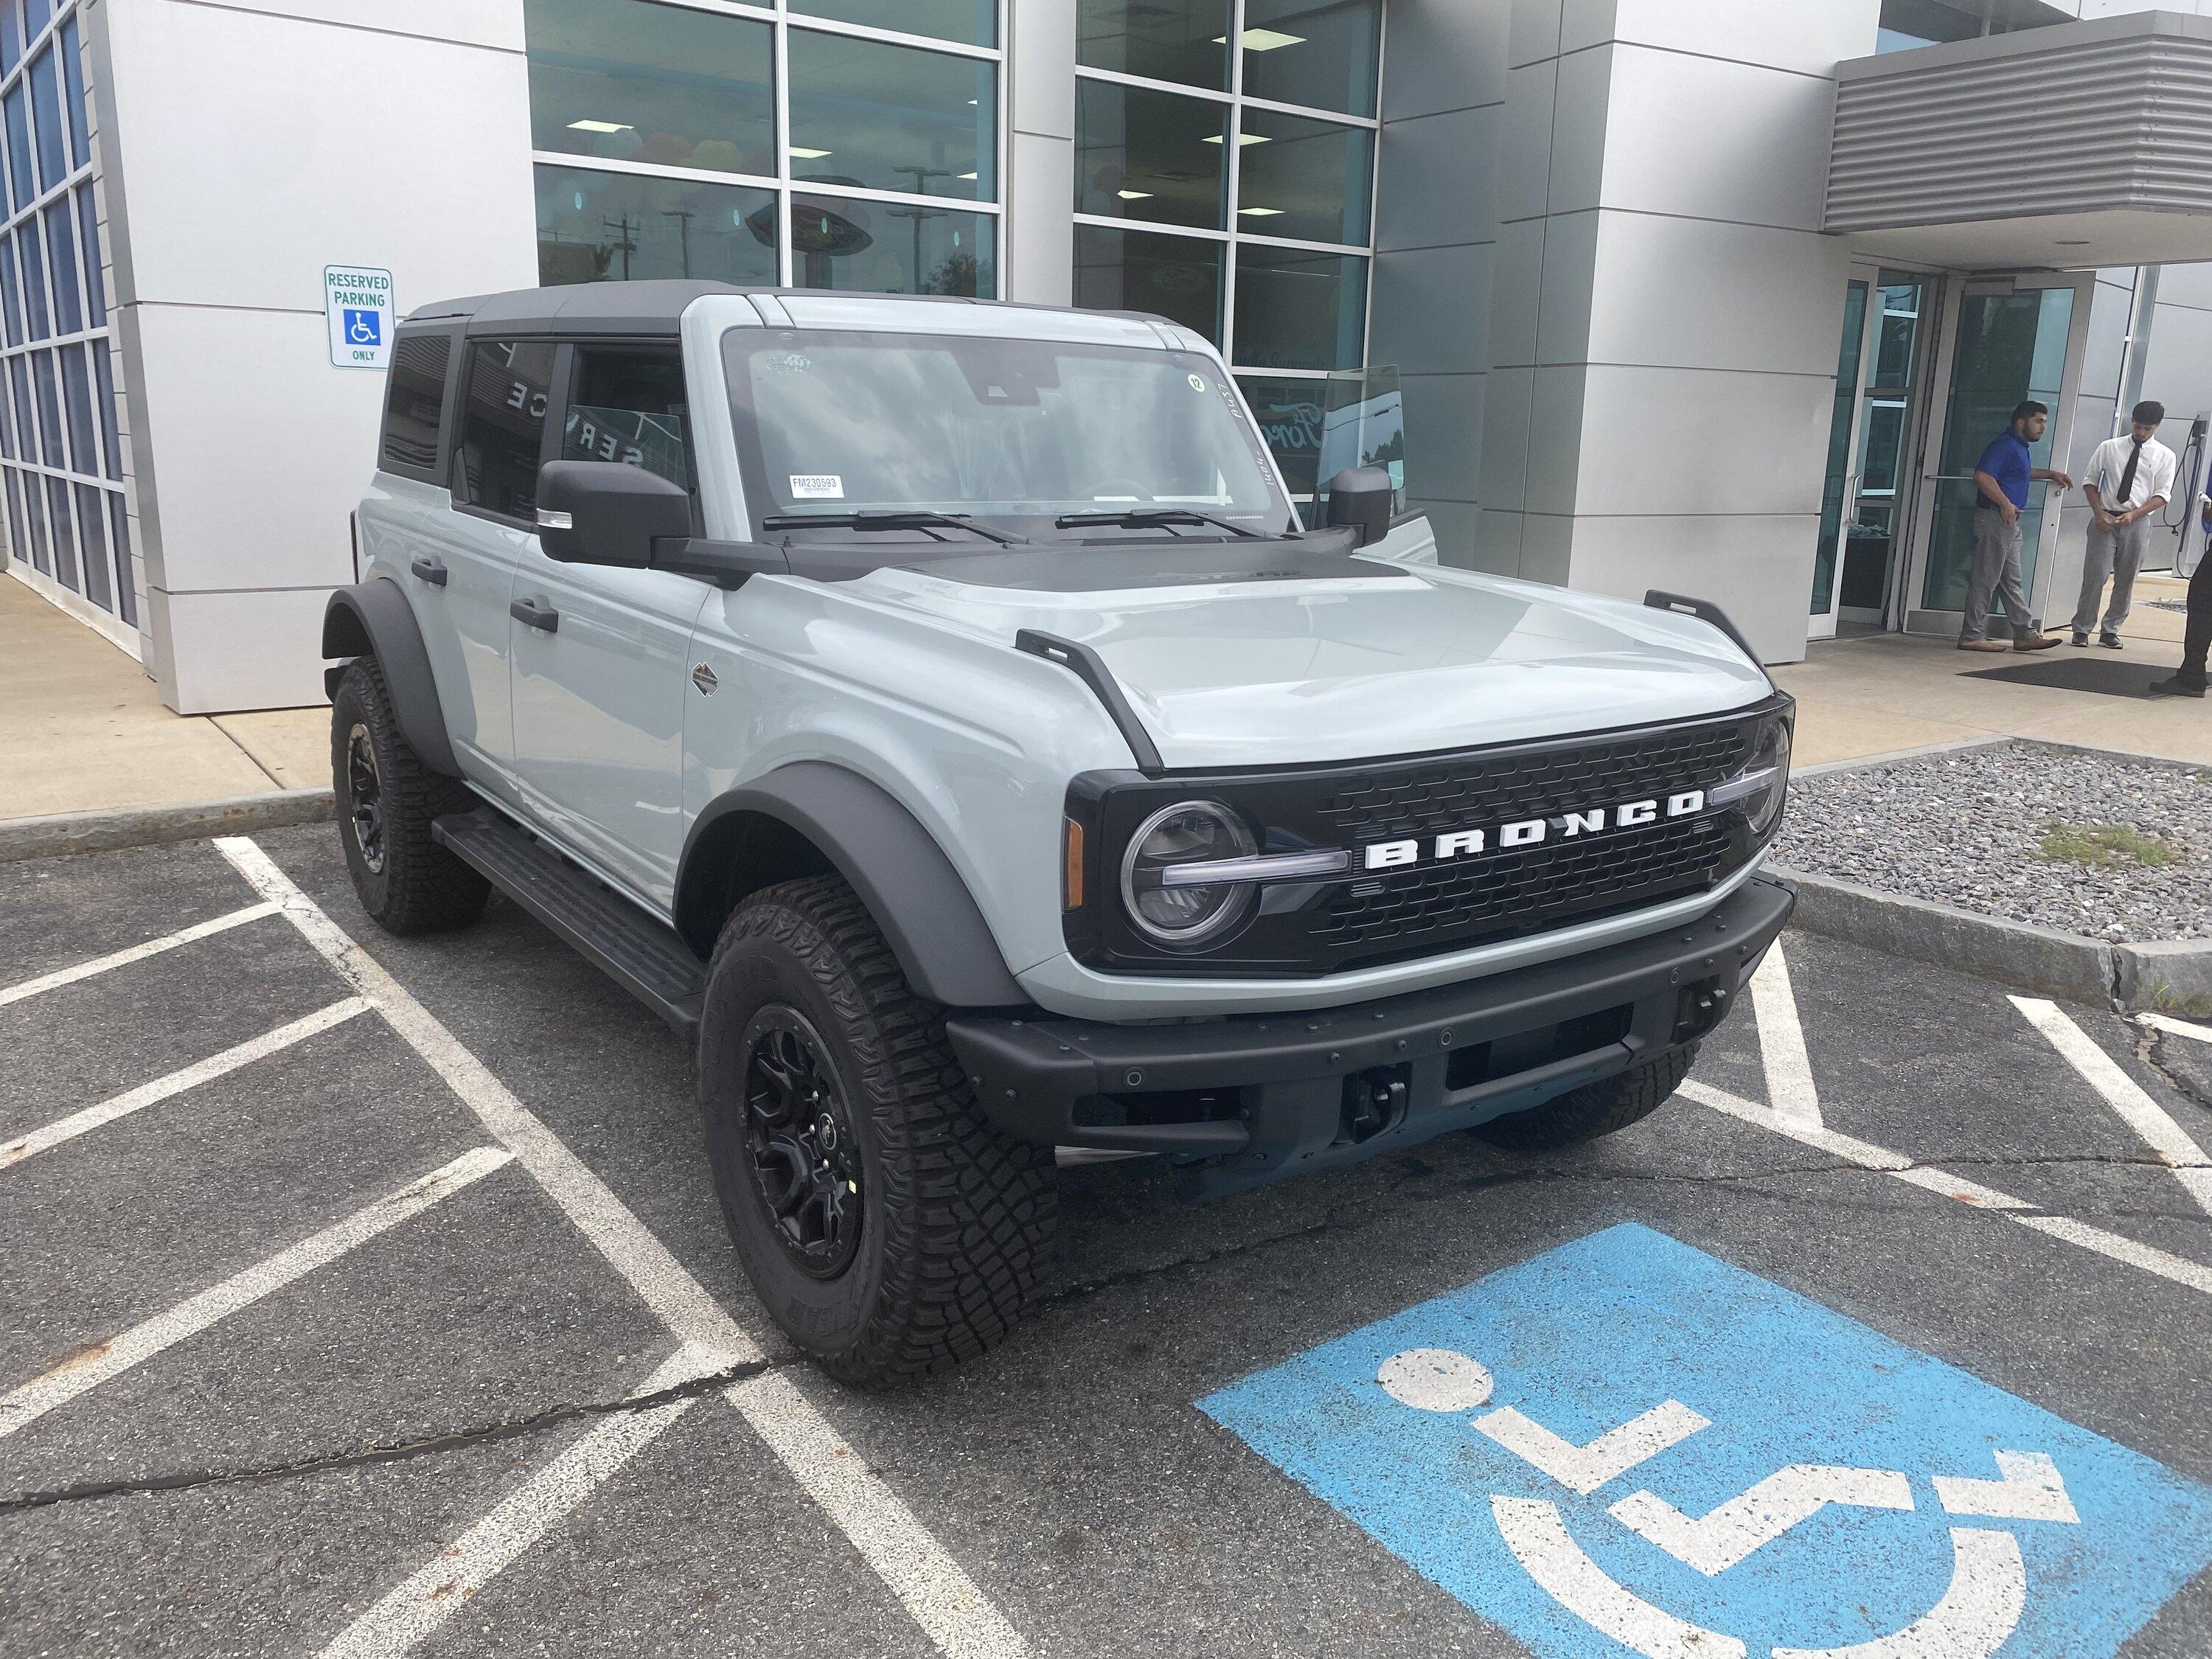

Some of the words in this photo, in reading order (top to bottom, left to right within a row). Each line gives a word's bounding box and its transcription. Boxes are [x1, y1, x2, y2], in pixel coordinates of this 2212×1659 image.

[328, 273, 389, 290] RESERVED
[334, 291, 385, 307] PARKING
[352, 350, 375, 361] ONLY
[1191, 378, 1203, 389] 12
[793, 478, 837, 487] FM230593
[1364, 790, 1705, 870] BRONCO
